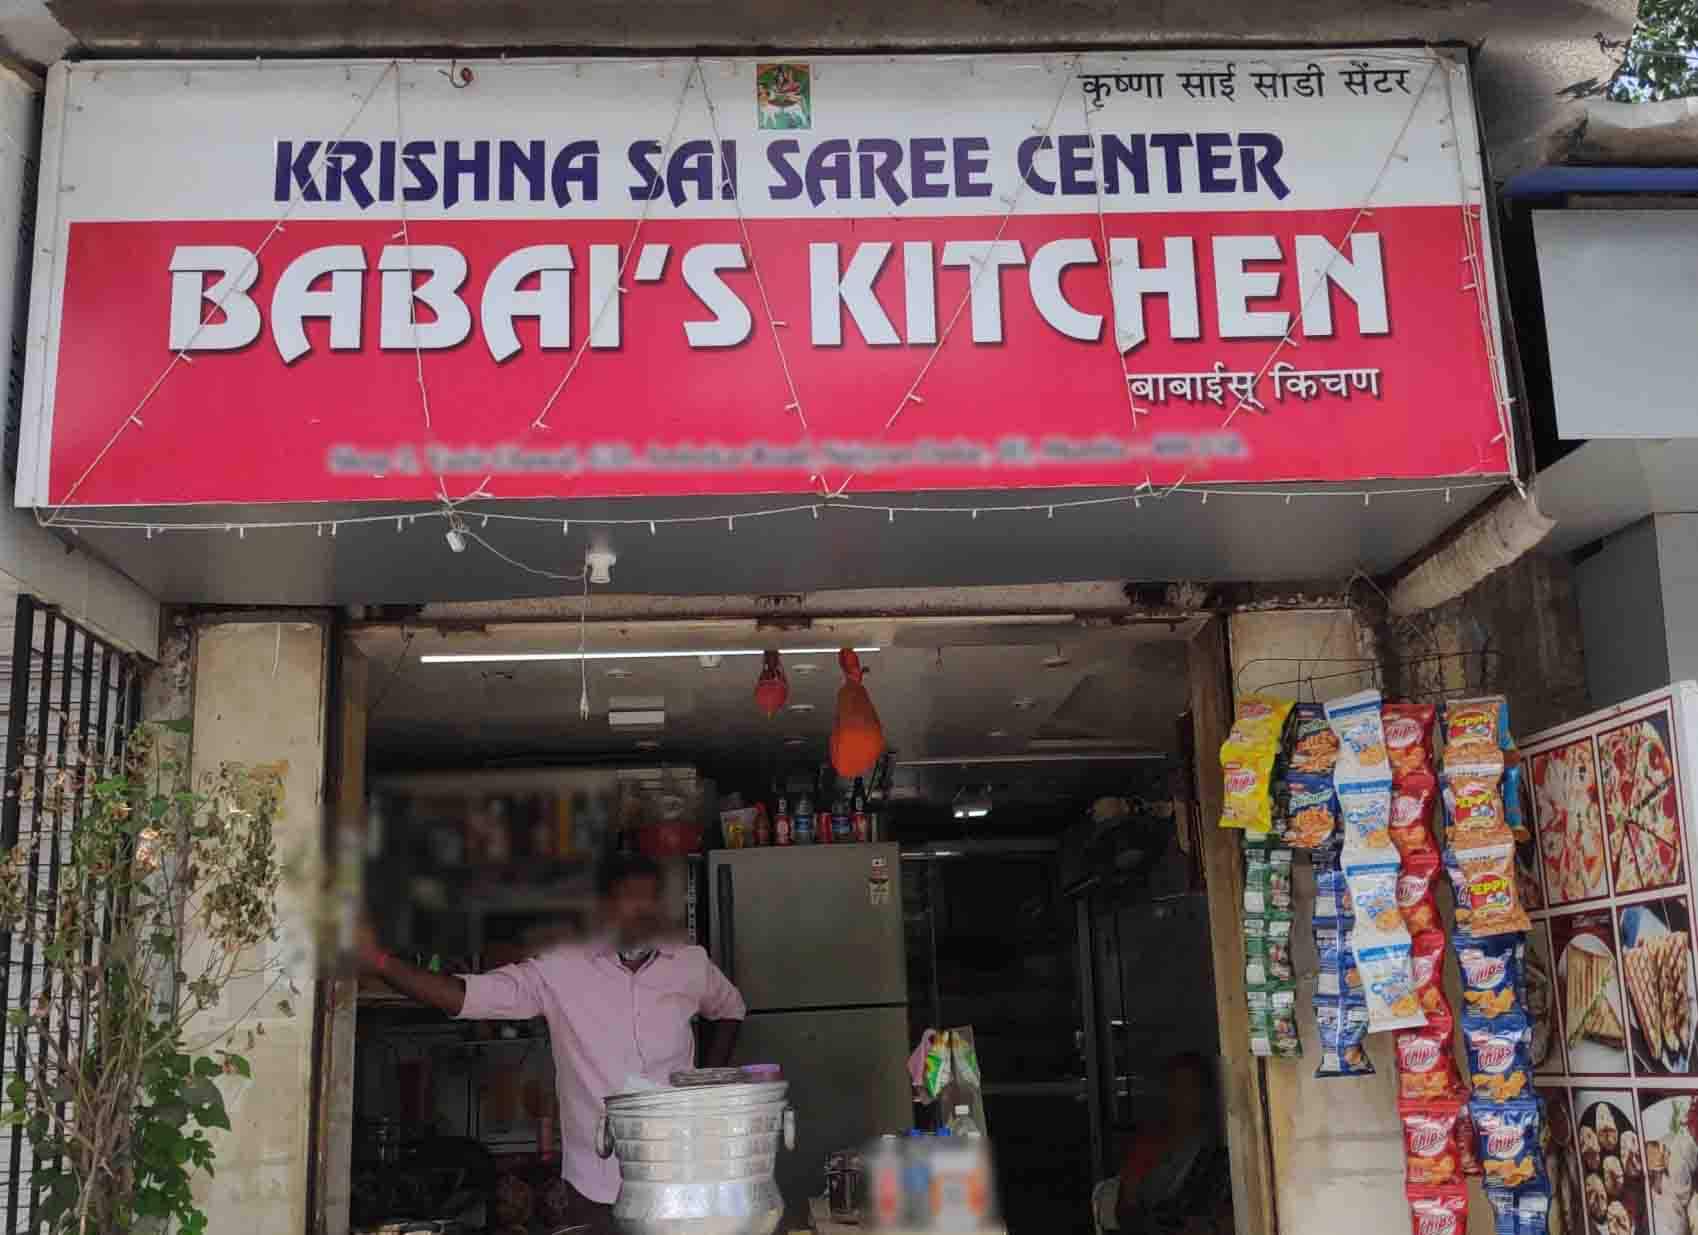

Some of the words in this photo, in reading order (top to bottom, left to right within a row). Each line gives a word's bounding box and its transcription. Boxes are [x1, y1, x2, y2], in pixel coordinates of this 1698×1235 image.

[1078, 73, 1163, 107] कृष्णा
[1177, 63, 1236, 101] साई
[1249, 62, 1325, 98] साडी
[1339, 62, 1411, 95] सेंटर
[275, 140, 599, 208] KRISHNA
[630, 140, 737, 208] SAI
[768, 137, 993, 205] SAREE
[1017, 132, 1290, 200] CENTER
[168, 242, 753, 363] BABAI'S
[809, 231, 1389, 353] KITCHEN
